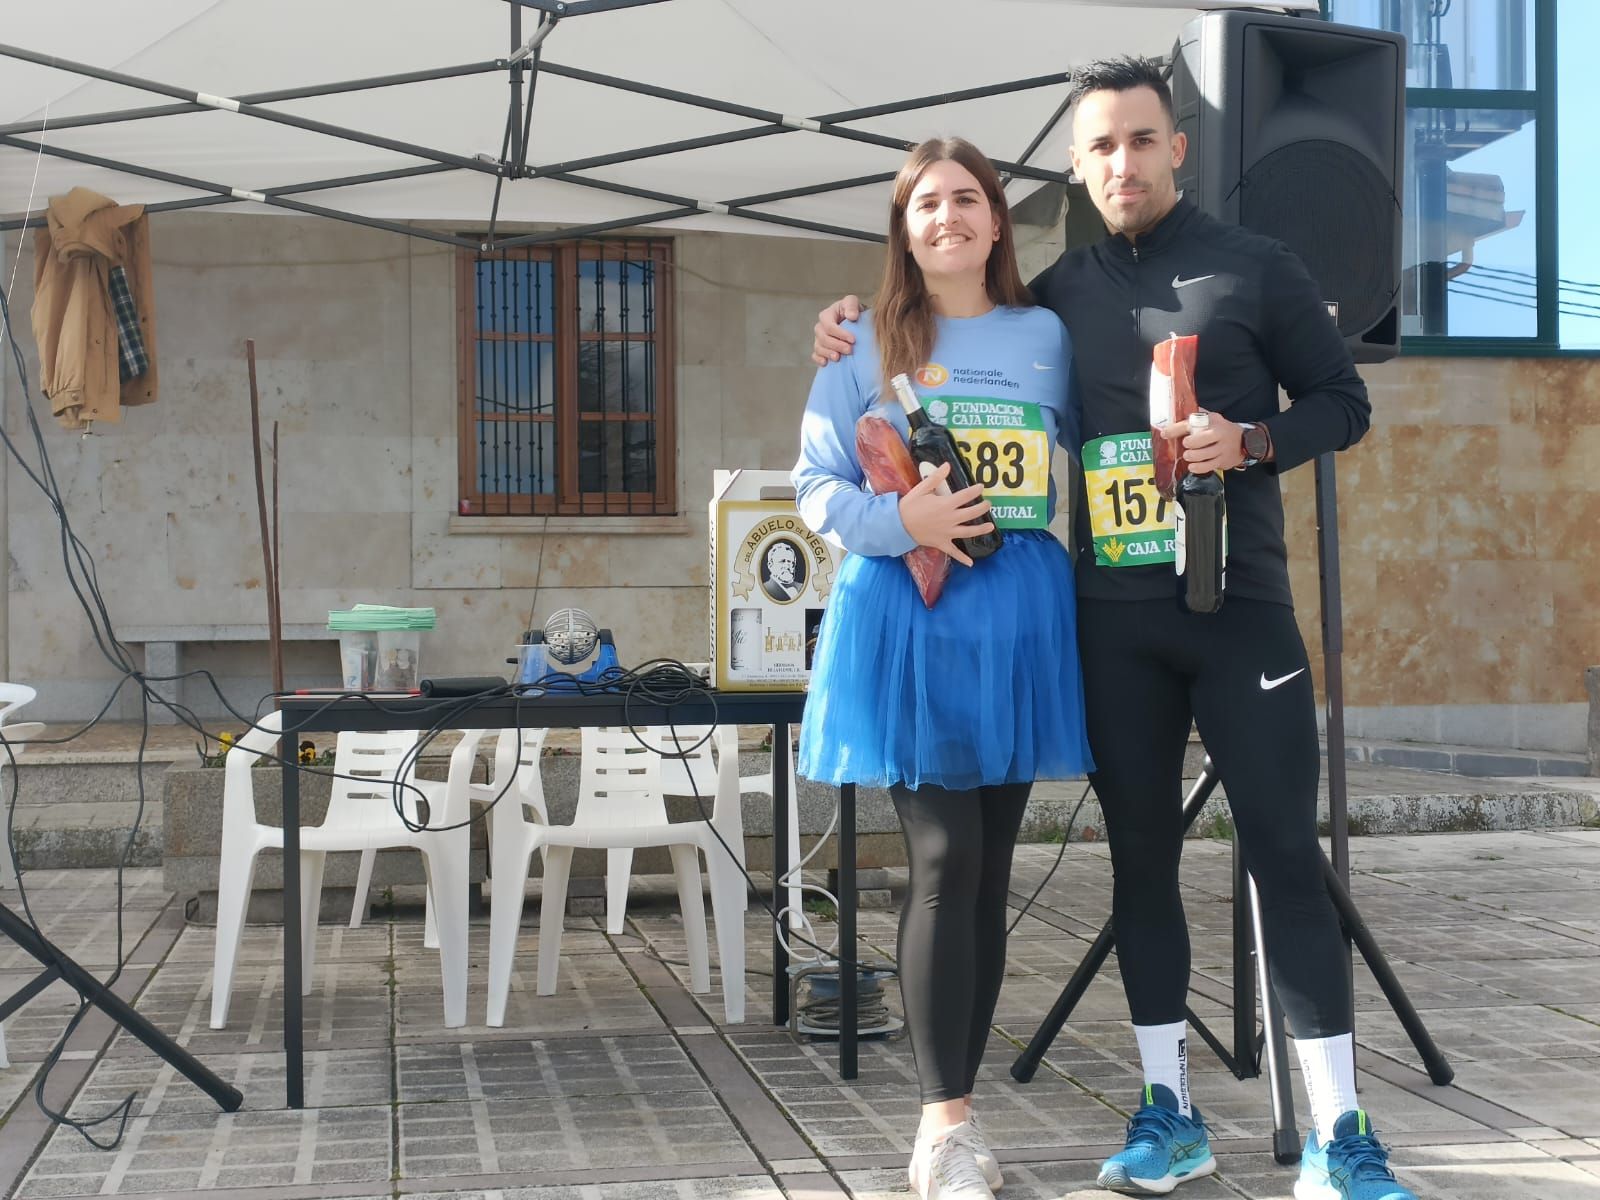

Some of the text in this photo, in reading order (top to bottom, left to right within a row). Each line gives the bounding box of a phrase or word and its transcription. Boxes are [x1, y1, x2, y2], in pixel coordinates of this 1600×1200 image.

[953, 367, 1003, 378] nationale
[953, 376, 1020, 389] nederlanden
[951, 401, 1025, 416] FUNDACION
[951, 414, 1027, 426] CAJA RURAL
[1120, 450, 1152, 463] CAJA
[989, 506, 1037, 519] RURAL
[747, 519, 795, 550] ABUELO
[806, 531, 826, 565] VEGA
[1126, 540, 1161, 556] CAJA
